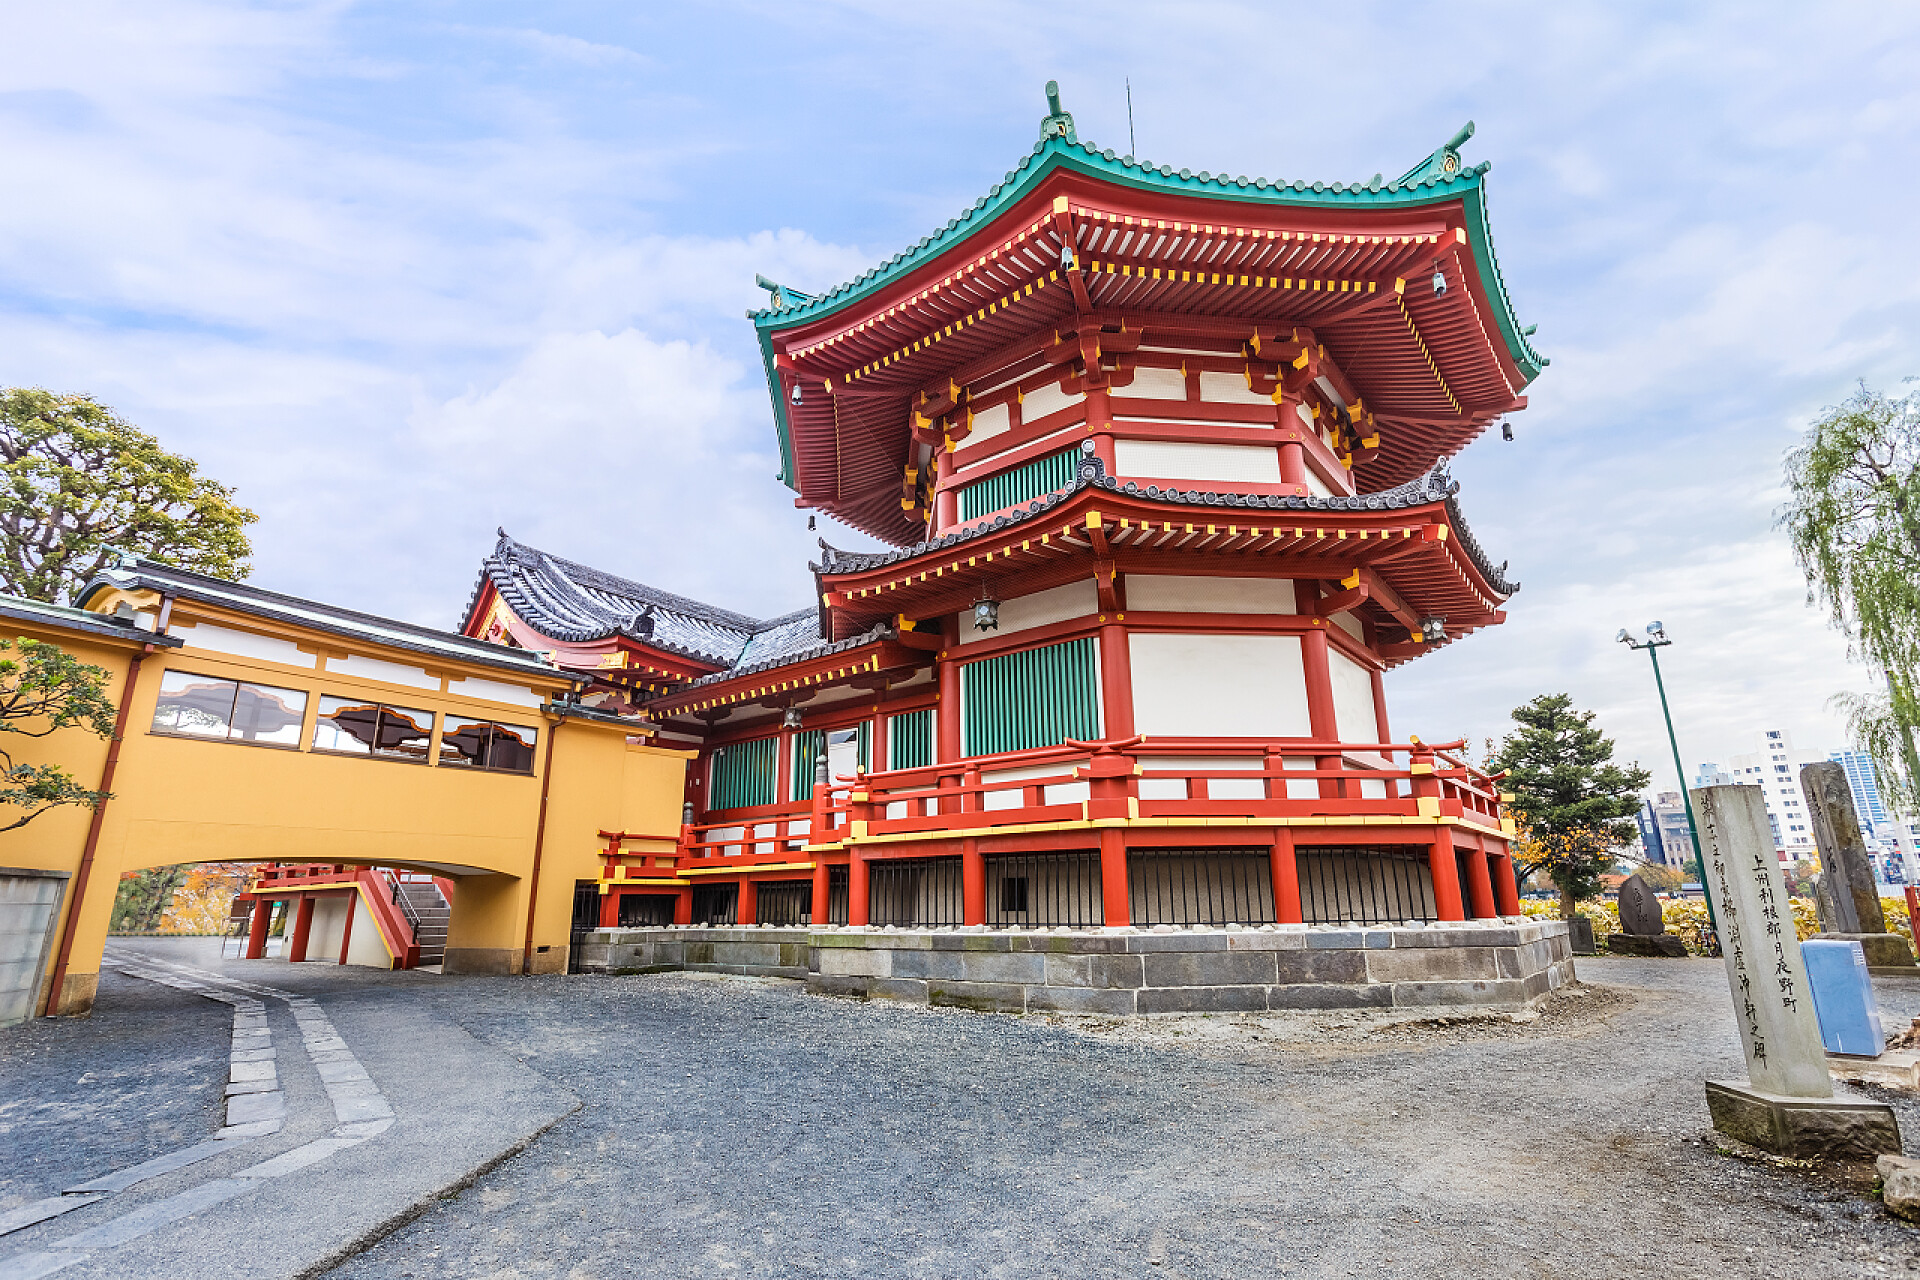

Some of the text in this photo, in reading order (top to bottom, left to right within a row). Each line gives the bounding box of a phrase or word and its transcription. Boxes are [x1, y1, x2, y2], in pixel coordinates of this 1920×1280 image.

[1752, 854, 1798, 1014] 上州利根郡月夜野町
